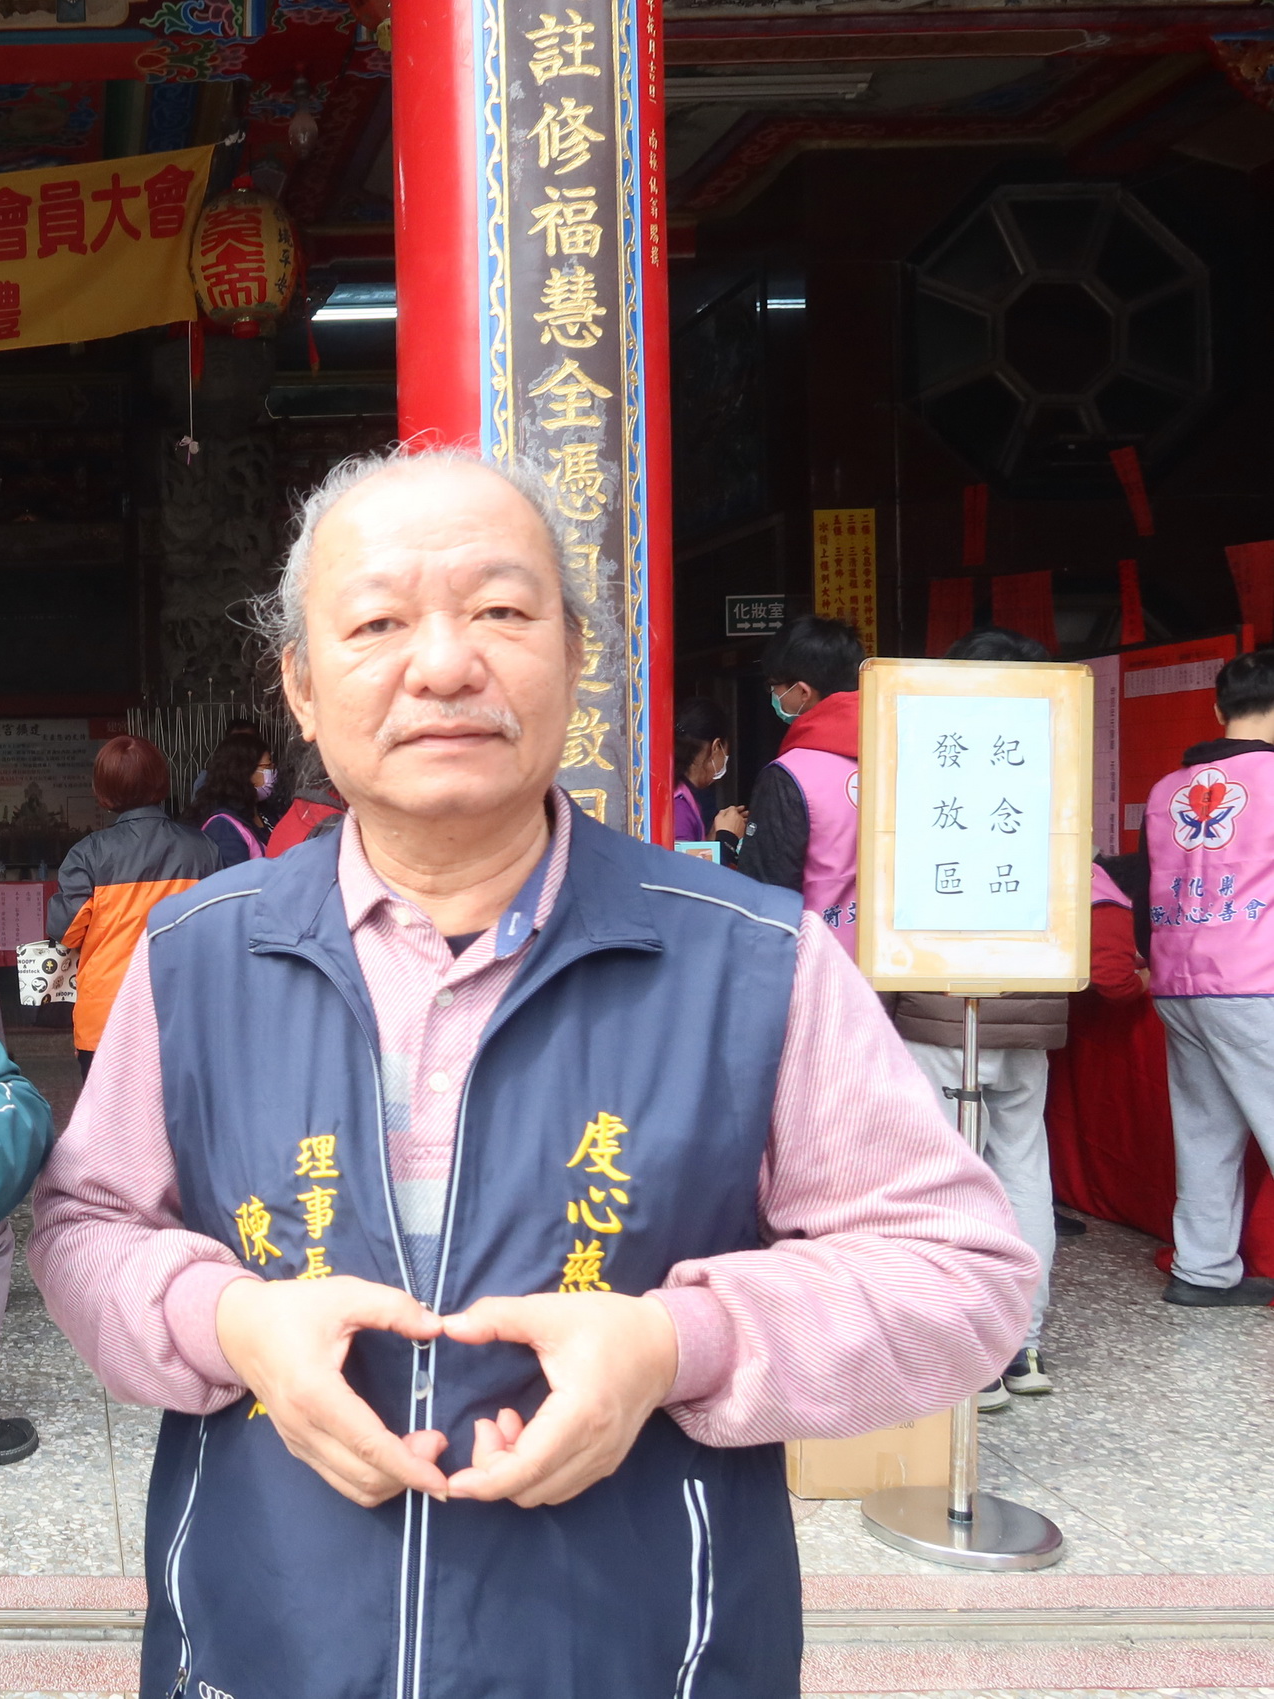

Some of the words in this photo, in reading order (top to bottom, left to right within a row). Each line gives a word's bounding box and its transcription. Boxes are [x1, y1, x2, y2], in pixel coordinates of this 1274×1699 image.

[931, 731, 970, 895] 發放區
[989, 734, 1026, 894] 紀念品
[294, 1133, 339, 1282] 理事長
